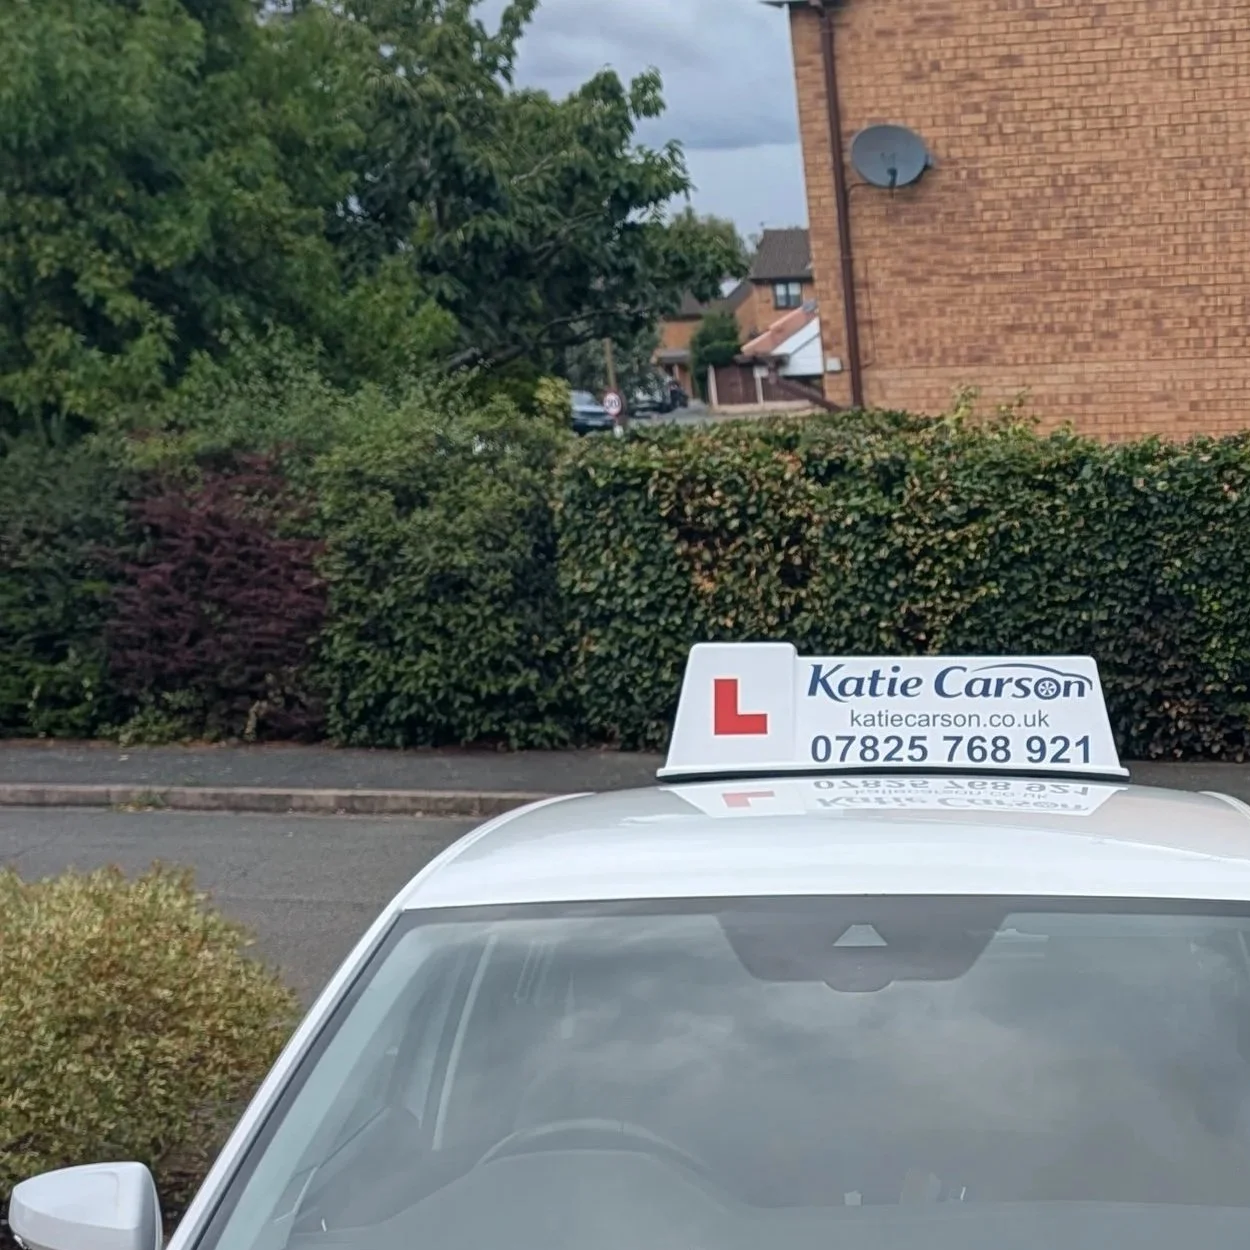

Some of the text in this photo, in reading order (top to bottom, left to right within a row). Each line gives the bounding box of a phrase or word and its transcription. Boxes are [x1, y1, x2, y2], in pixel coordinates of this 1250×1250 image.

[808, 664, 1087, 703] Katie Carson
[714, 678, 768, 735] L
[850, 709, 1050, 728] katiecarson.co.uk
[811, 735, 1090, 764] 07825 768 921
